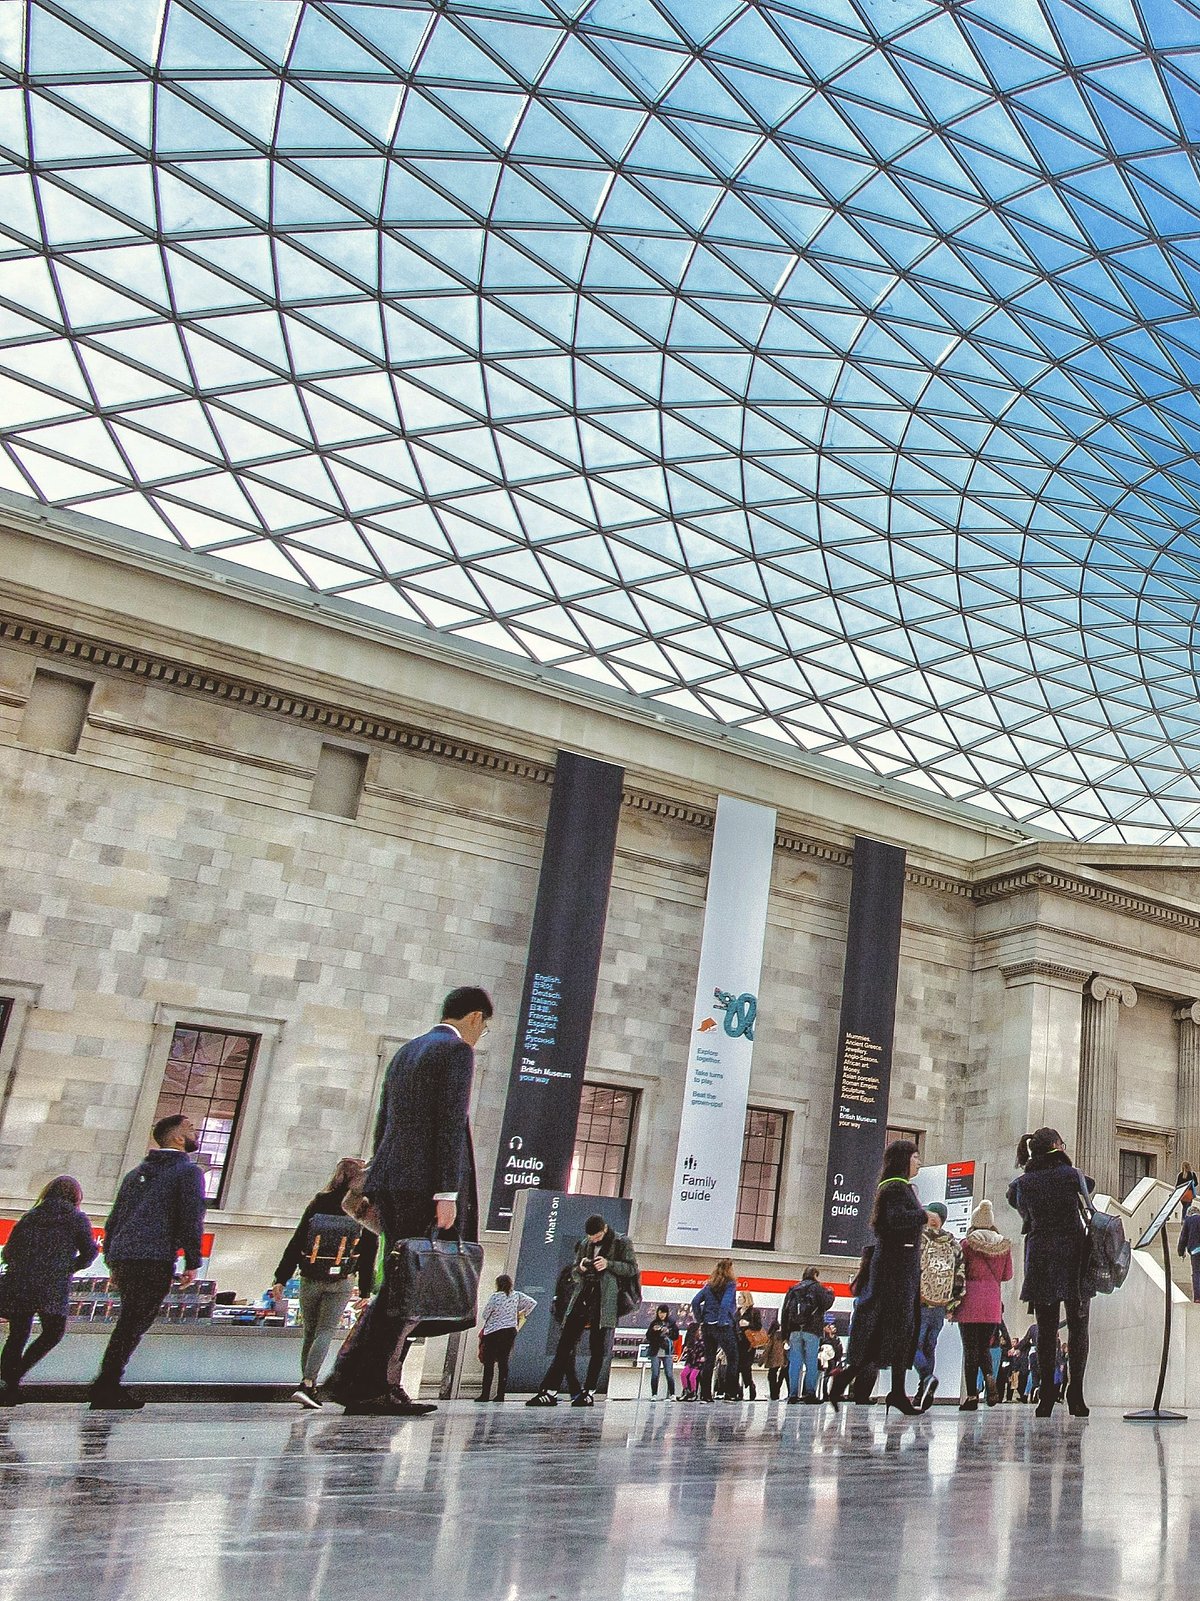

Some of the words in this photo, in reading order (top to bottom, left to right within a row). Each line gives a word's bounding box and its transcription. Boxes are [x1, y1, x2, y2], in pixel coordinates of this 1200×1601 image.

[535, 974, 561, 983] English.
[533, 989, 561, 998] Deutsch.
[532, 997, 558, 1006] Italiano.
[529, 1012, 558, 1021] Français.
[528, 1020, 556, 1029] Español.
[846, 1039, 863, 1047] Ancient
[522, 1057, 534, 1065] The
[521, 1066, 541, 1075] British
[544, 1070, 571, 1078] Museum
[520, 1074, 534, 1083] your
[858, 1075, 880, 1083] porcelain.
[842, 1086, 866, 1094] Sculpture.
[860, 1082, 878, 1090] Empire.
[507, 1156, 543, 1170] Audio
[505, 1172, 541, 1185] guide
[683, 1175, 717, 1189] Family
[681, 1190, 711, 1202] guide
[832, 1190, 860, 1202] Audio
[551, 1197, 560, 1209] on
[831, 1205, 858, 1217] guide
[544, 1210, 559, 1244] What's
[662, 1276, 680, 1284] Audio
